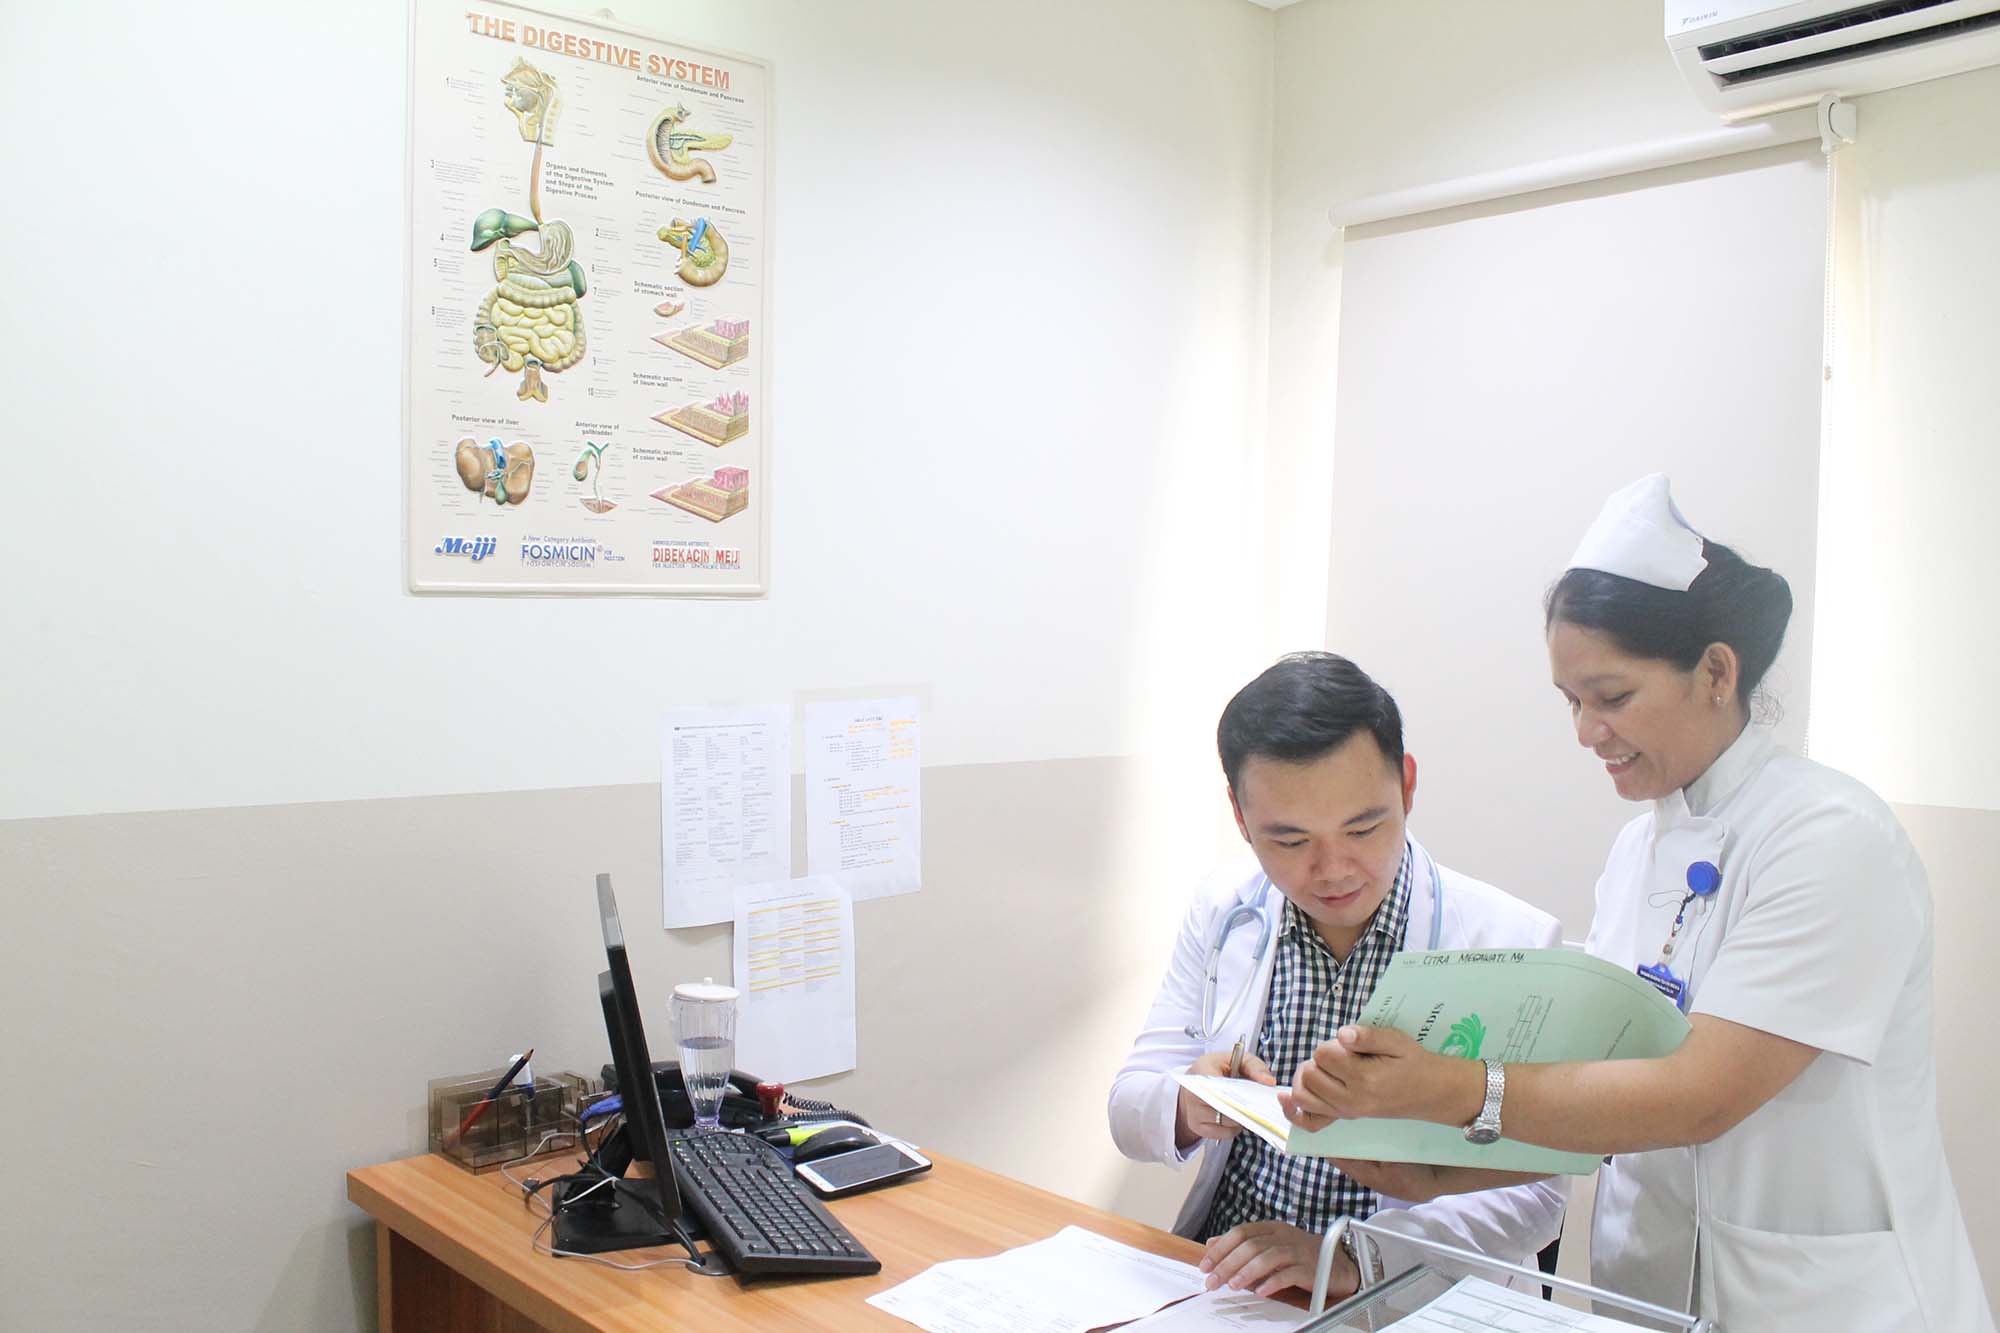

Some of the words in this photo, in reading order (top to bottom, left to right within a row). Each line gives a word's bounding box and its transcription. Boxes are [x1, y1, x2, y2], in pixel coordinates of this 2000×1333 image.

[467, 12, 515, 42] THE
[522, 24, 641, 70] DIGESTIVE
[647, 53, 730, 89] SYSTEM
[546, 161, 567, 170] Organs
[581, 168, 608, 178] Elements
[558, 179, 575, 188] Steps
[564, 173, 592, 182] Digestive
[593, 178, 614, 186] System
[546, 186, 572, 196] Digestive
[574, 190, 598, 200] Process
[452, 414, 480, 422] Posterior
[435, 536, 496, 561] Meiji
[522, 544, 595, 560] FOSMICIN
[653, 548, 710, 562] DIBEKACIN
[1424, 954, 1450, 966] CITRA
